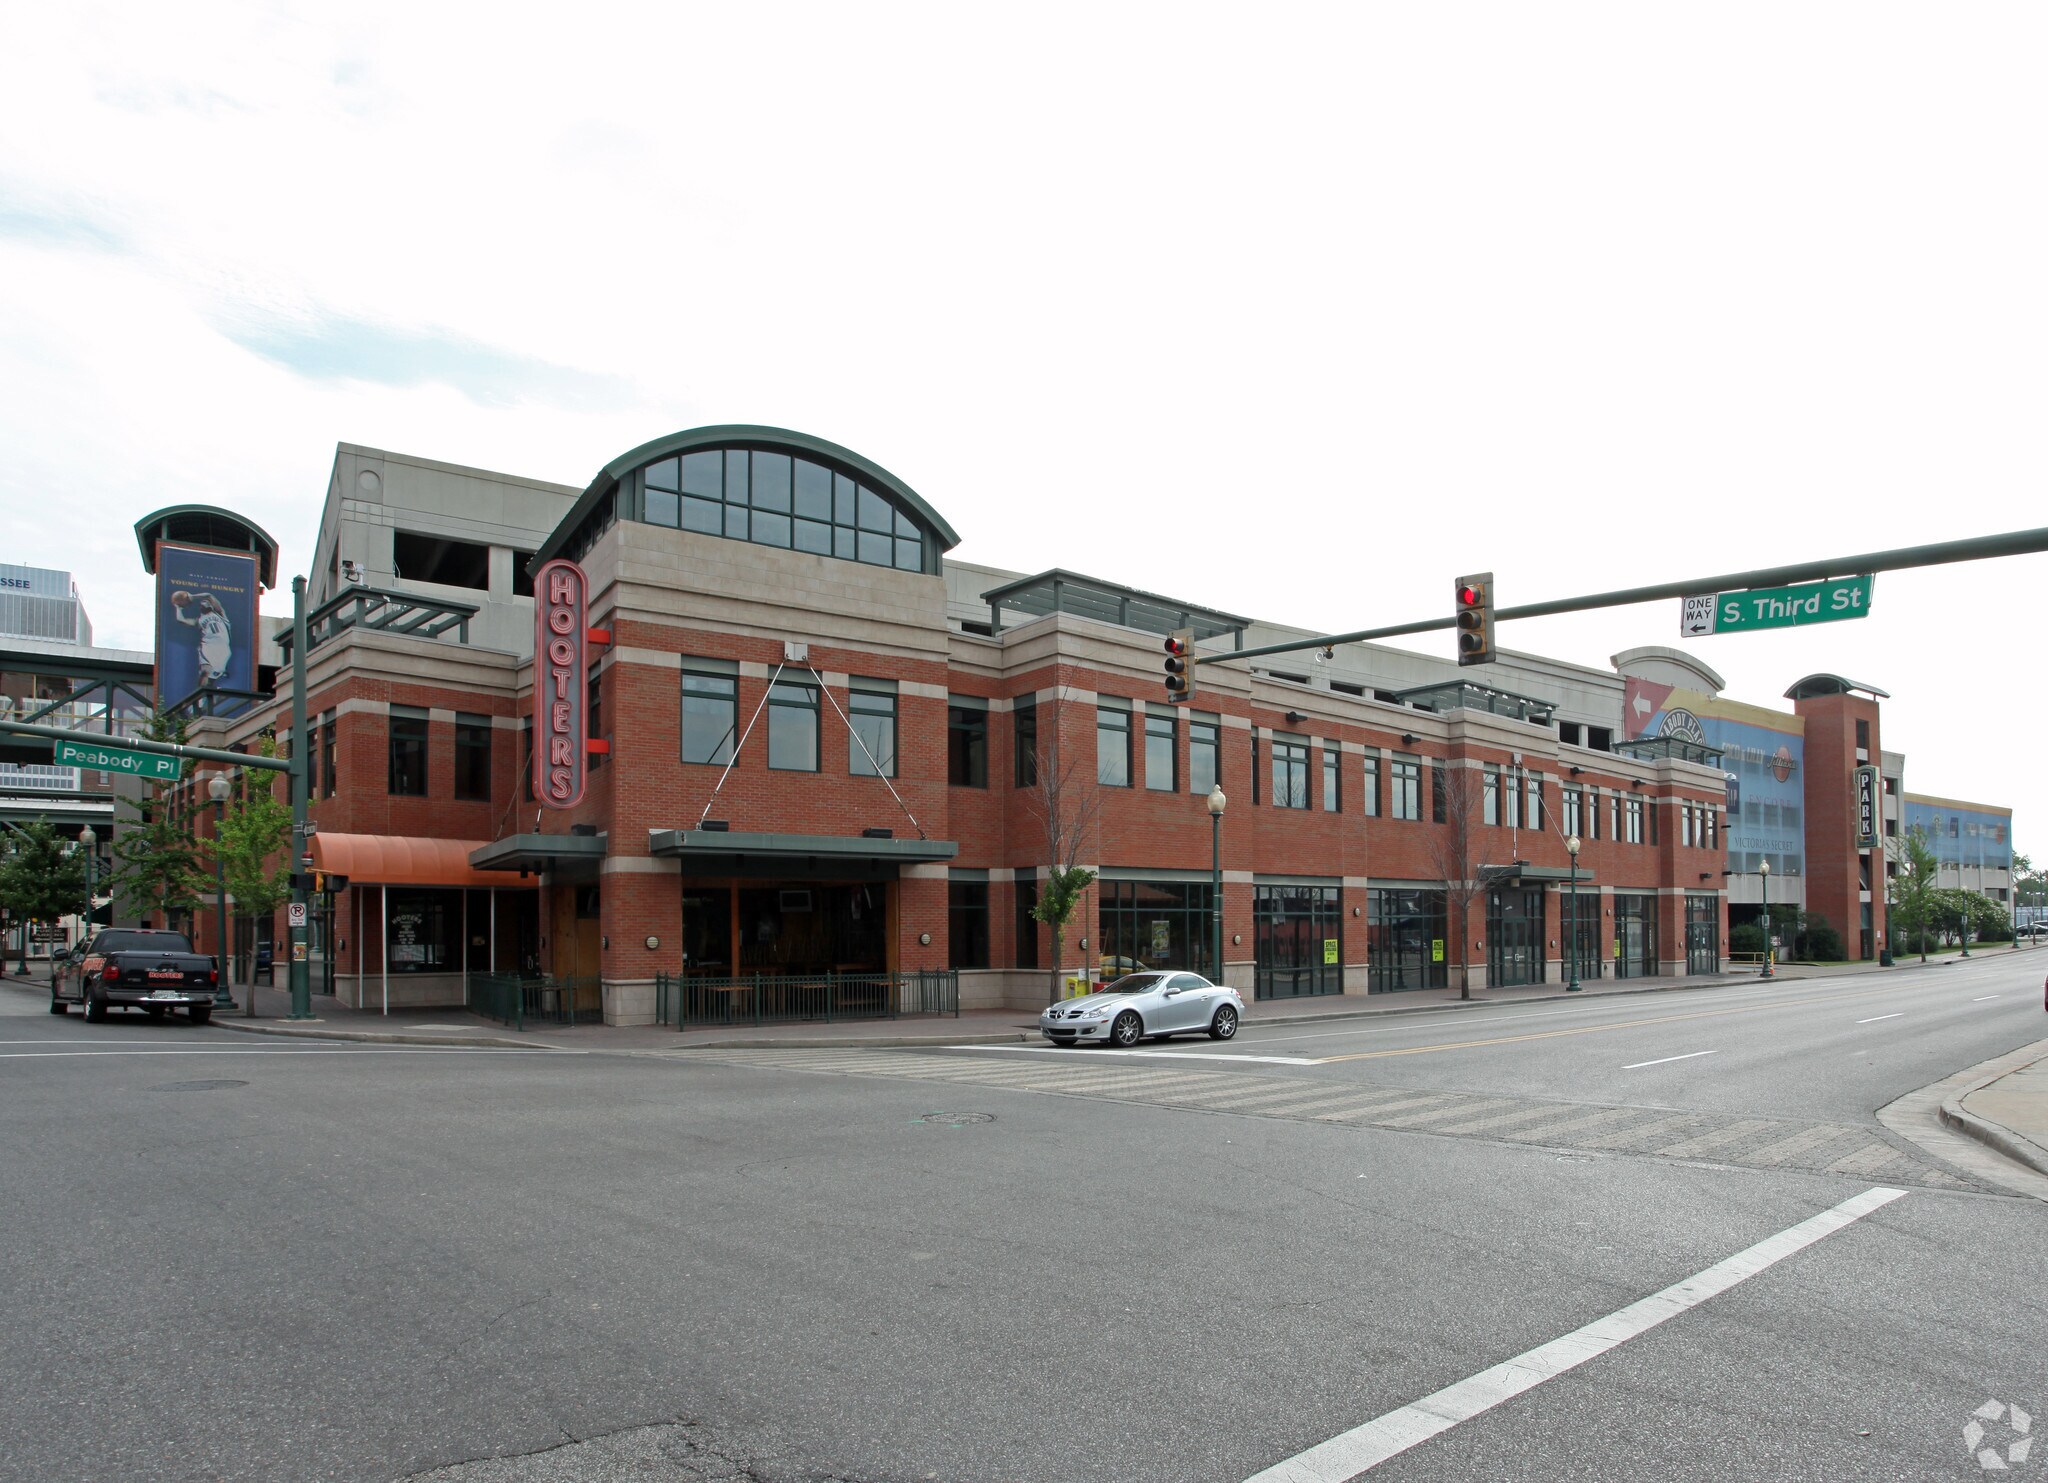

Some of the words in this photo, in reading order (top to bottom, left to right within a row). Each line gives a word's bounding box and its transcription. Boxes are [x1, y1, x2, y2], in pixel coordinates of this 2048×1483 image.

[170, 579, 199, 588] YOUNG
[211, 584, 245, 593] HUNGRY
[1688, 597, 1713, 610] ONE
[1722, 602, 1746, 623] S.
[1753, 592, 1821, 620] Third
[1831, 587, 1862, 610] St
[1686, 608, 1713, 621] WAY
[549, 572, 576, 799] HOOTERS
[63, 747, 143, 772] Peabody
[156, 760, 175, 774] Pl
[1861, 774, 1871, 833] PARK
[1771, 840, 1793, 851] SECRET
[148, 971, 184, 980] HOOTERS
